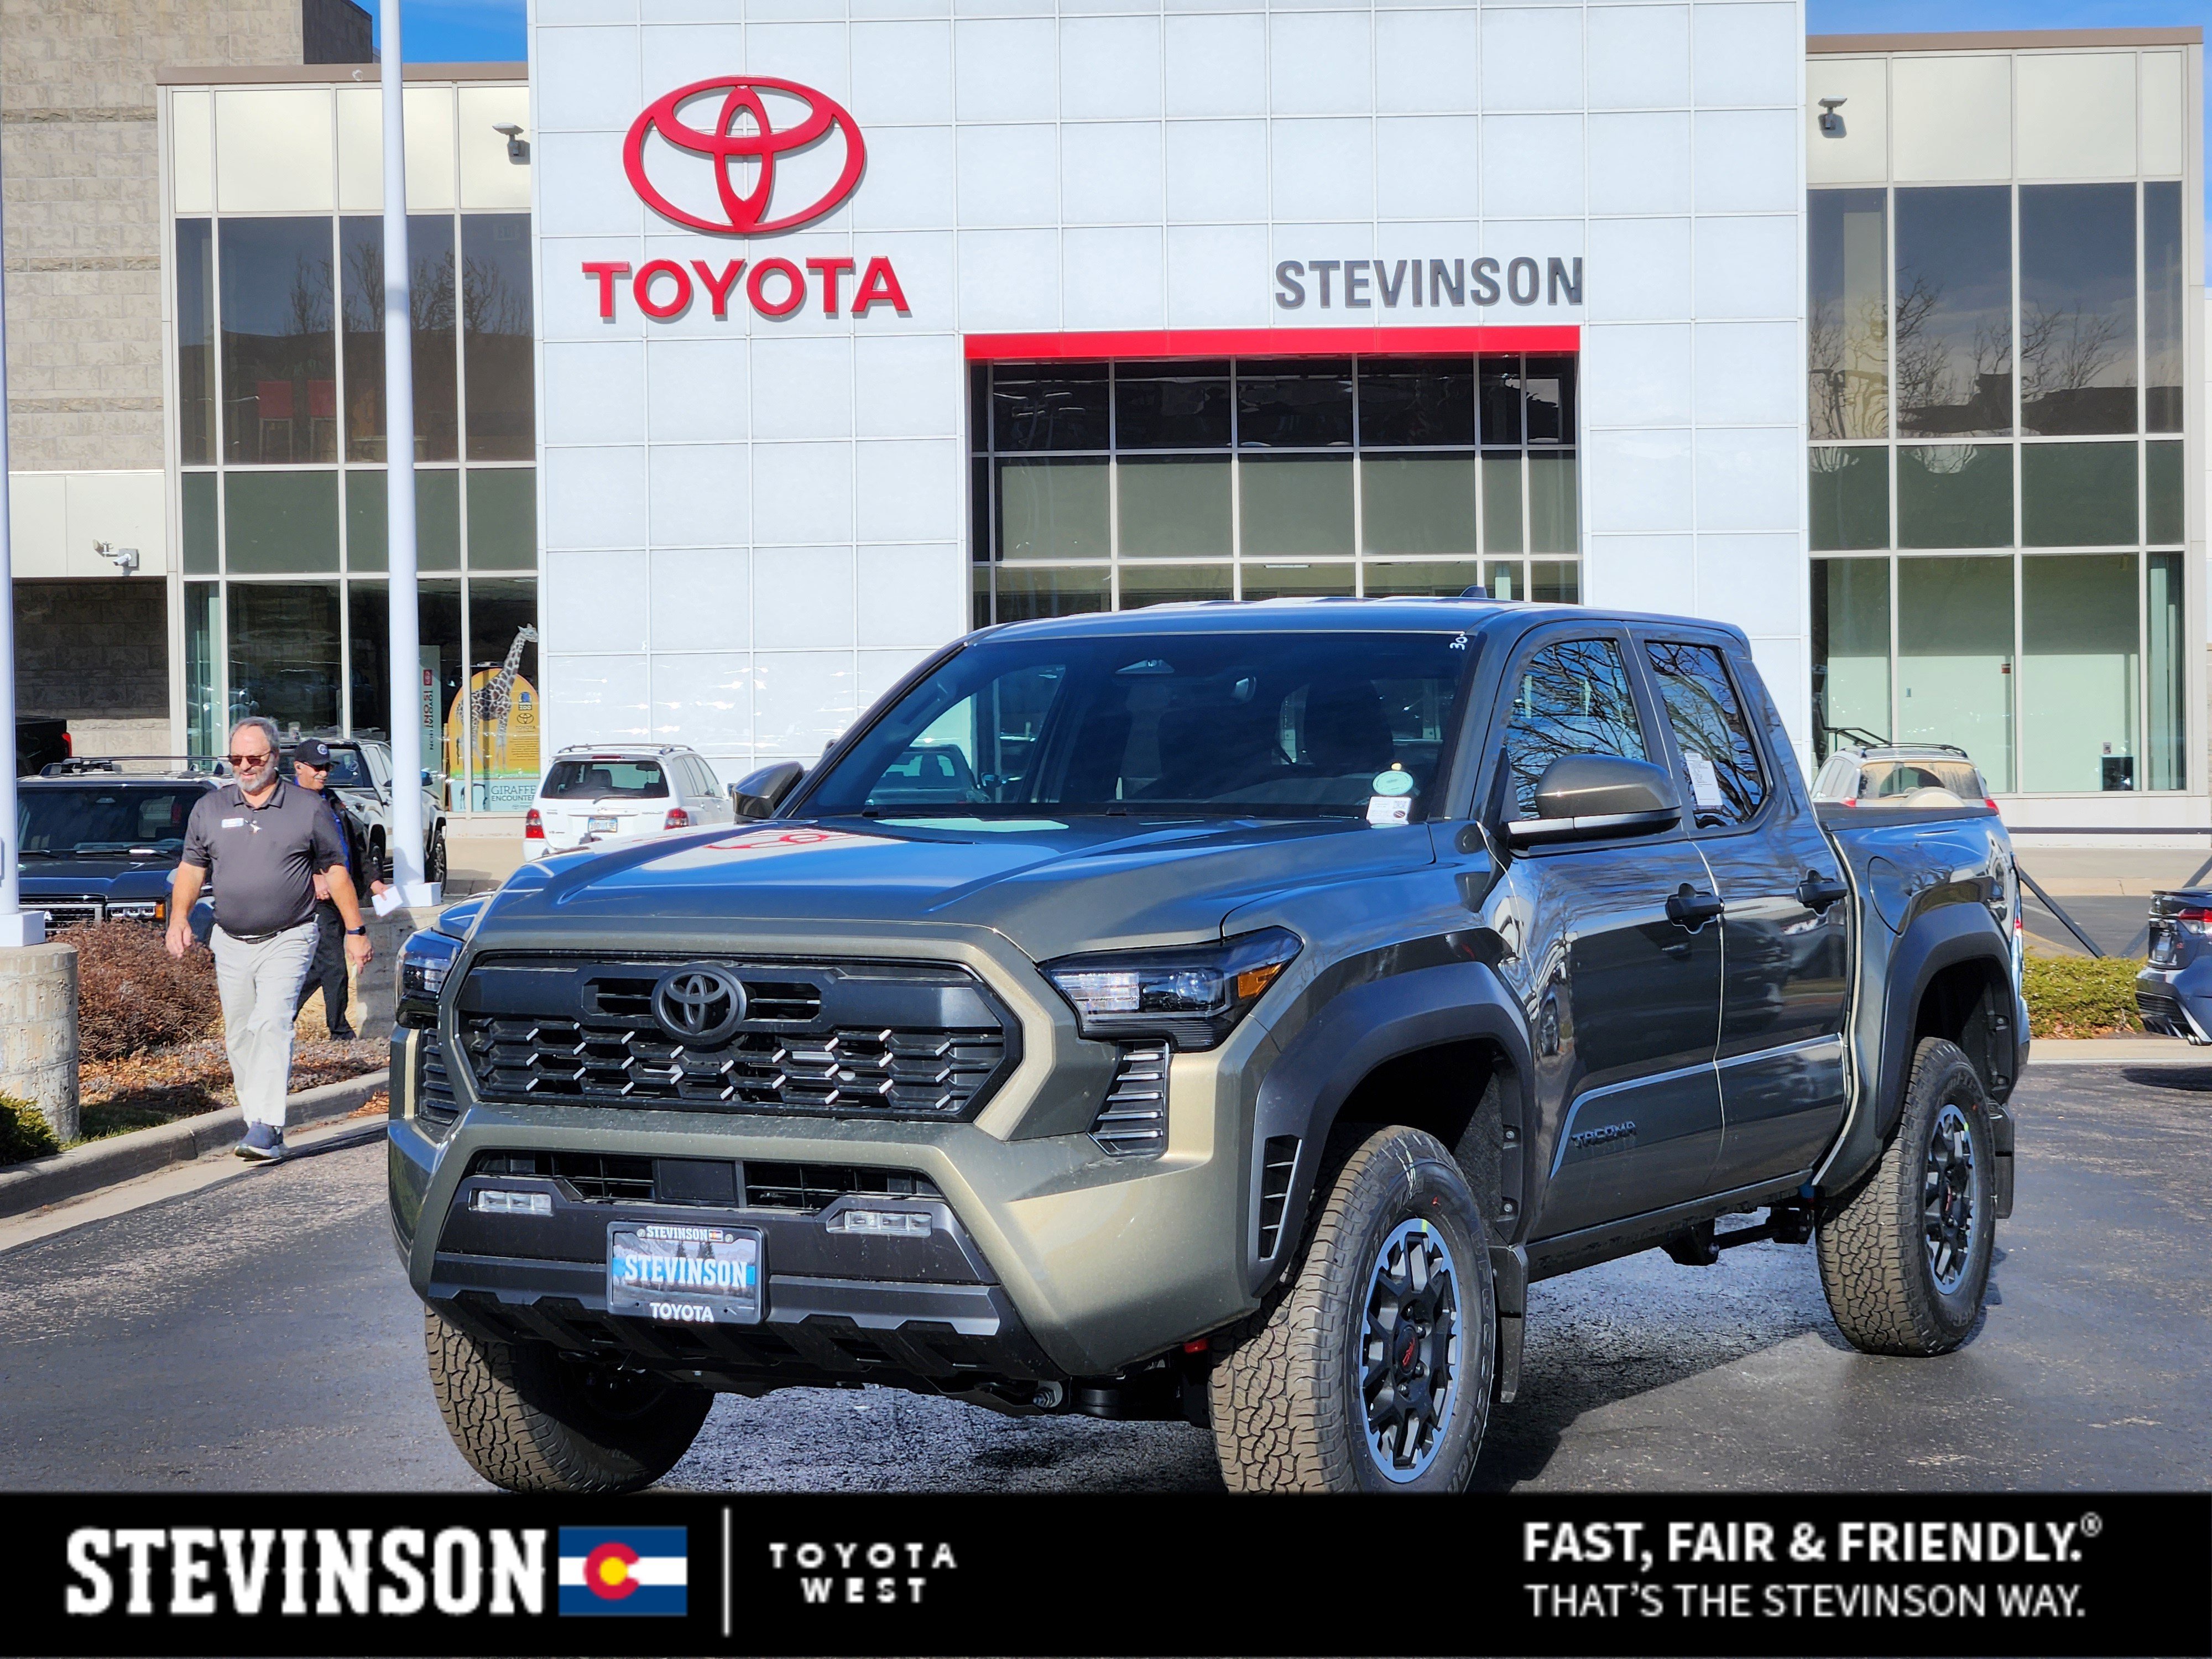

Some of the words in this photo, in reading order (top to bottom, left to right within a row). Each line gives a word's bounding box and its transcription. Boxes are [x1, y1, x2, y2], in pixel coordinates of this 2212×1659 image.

[581, 256, 910, 319] TOYOTA
[1275, 256, 1583, 308] STEVINSON
[491, 785, 536, 795] GIRAFFE
[645, 1225, 709, 1241] STEVINSON
[624, 1254, 748, 1288] STEVINSON
[649, 1302, 714, 1323] TOYOTA
